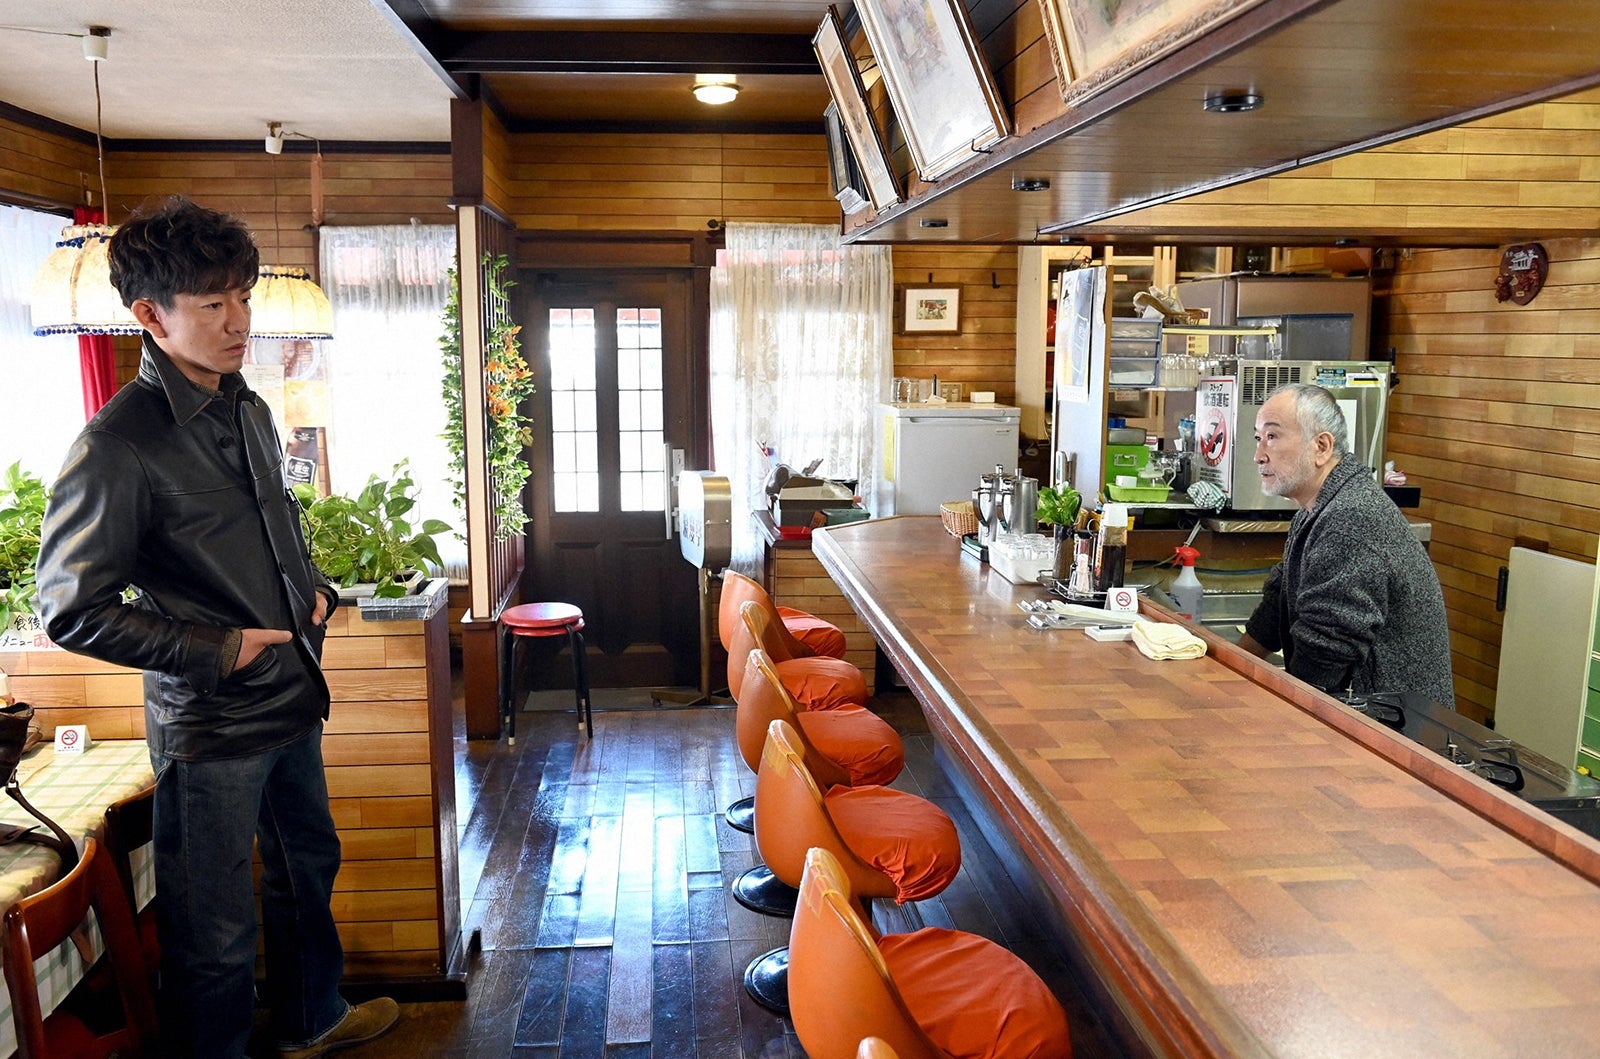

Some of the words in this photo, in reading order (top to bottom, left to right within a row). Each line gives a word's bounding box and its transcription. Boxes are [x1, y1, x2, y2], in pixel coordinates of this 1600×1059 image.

[14, 615, 42, 631] 食後
[2, 635, 33, 647] メニュー
